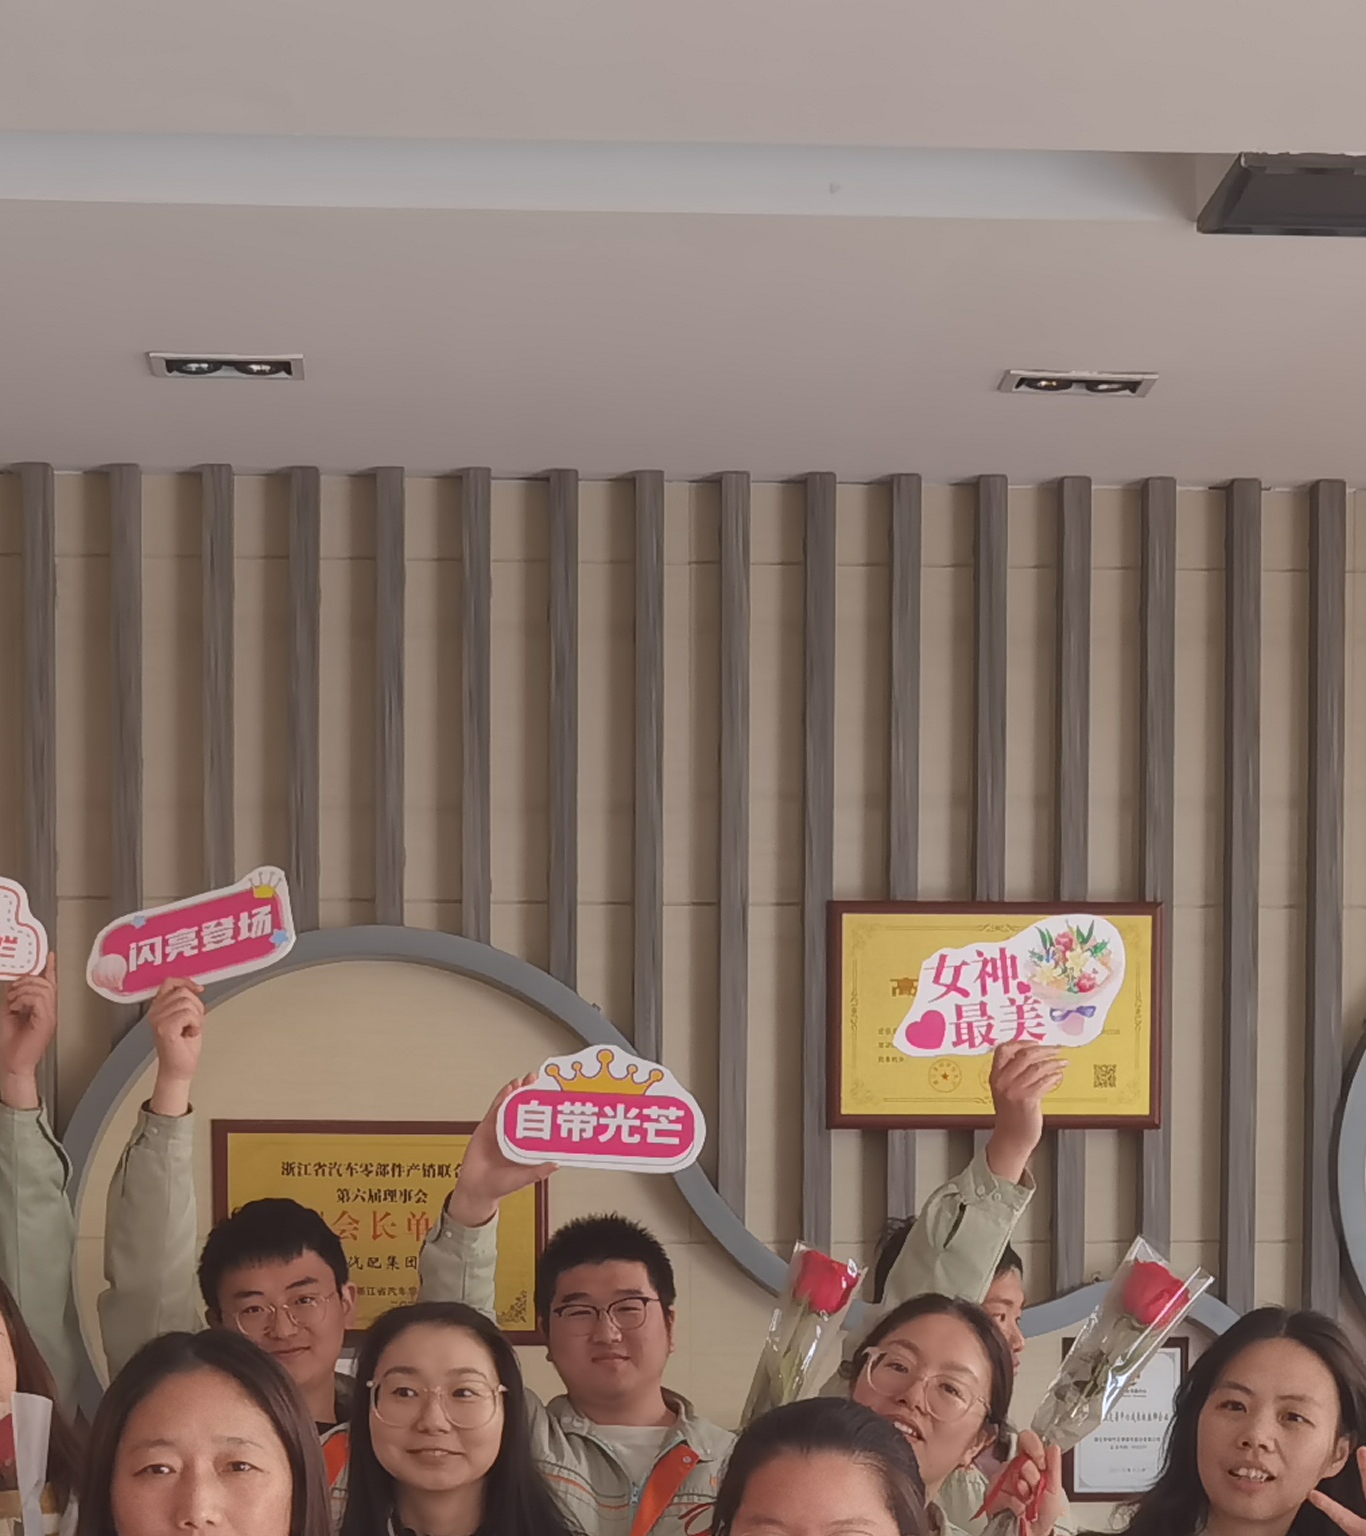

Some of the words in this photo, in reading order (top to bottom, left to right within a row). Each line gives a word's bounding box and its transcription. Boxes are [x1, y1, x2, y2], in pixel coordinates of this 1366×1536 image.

[129, 904, 272, 973] 闪亮登场
[923, 946, 1020, 1003] 女神
[949, 995, 1047, 1049] 最美
[516, 1100, 685, 1145] 自带光芒
[336, 1188, 428, 1204] 第六届理事会
[320, 1210, 432, 1241] 会长单
